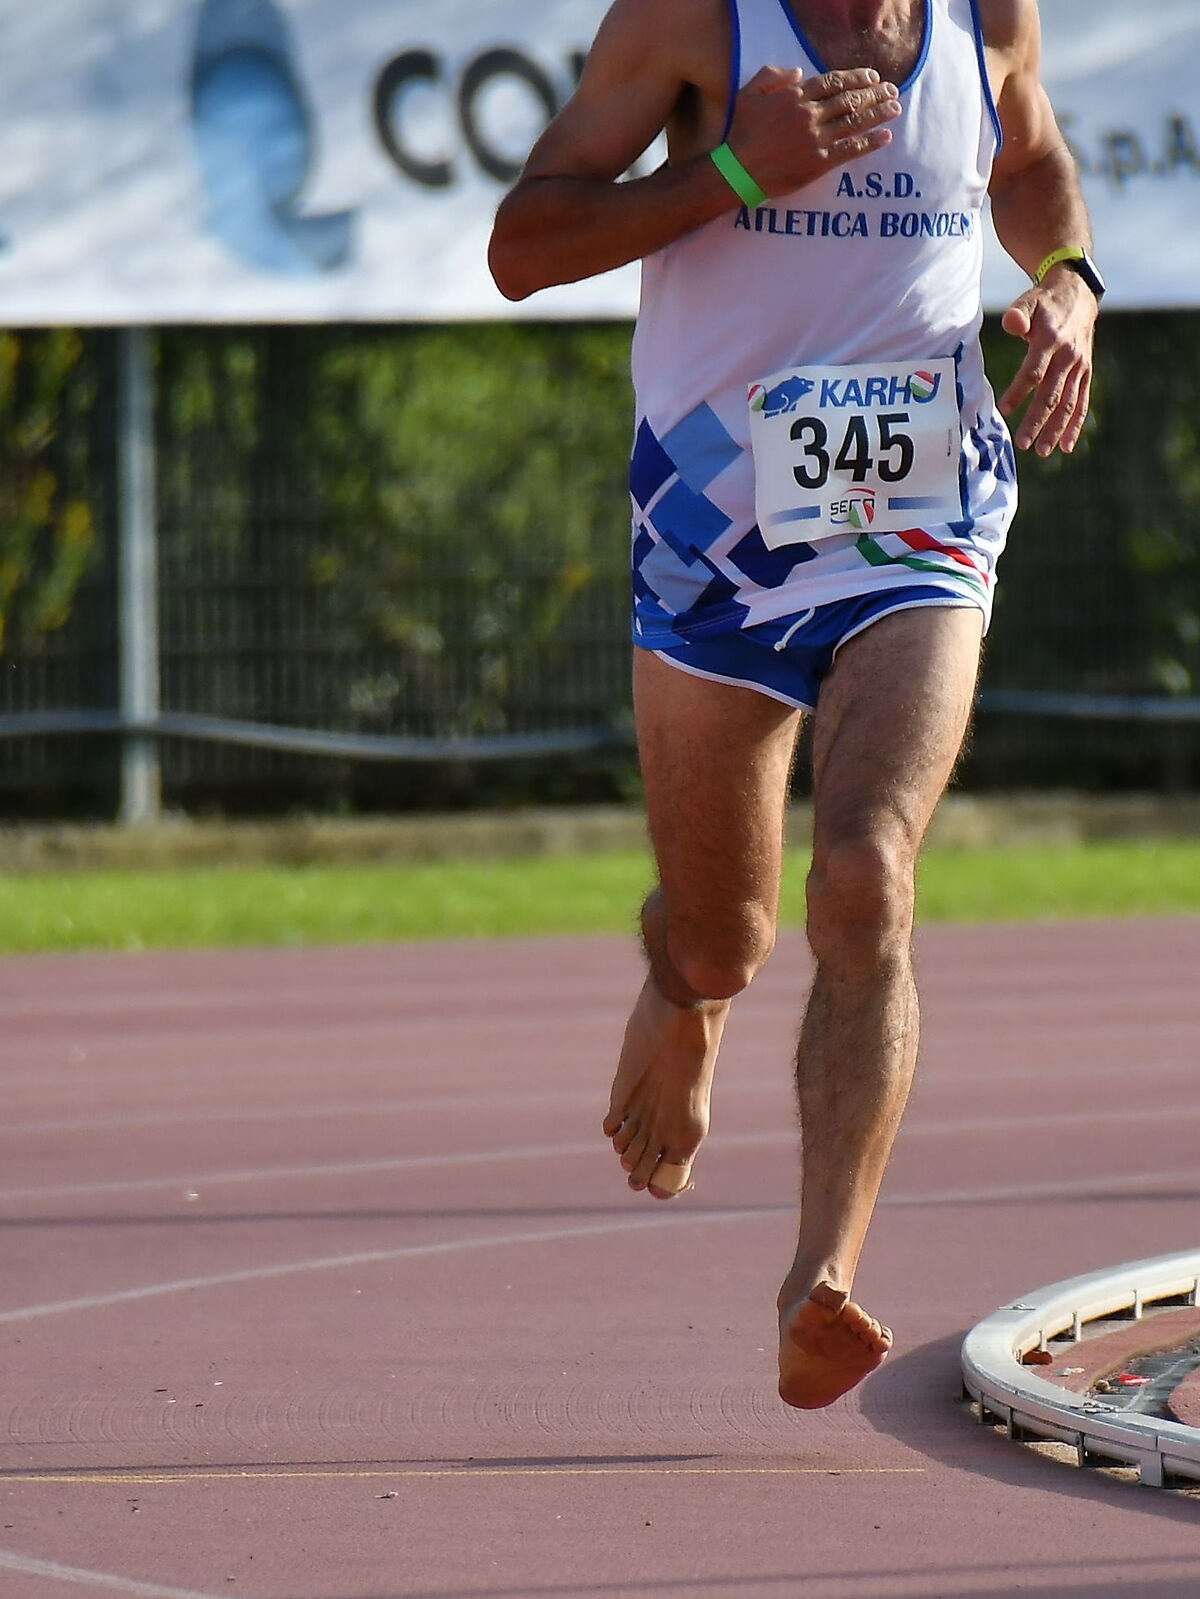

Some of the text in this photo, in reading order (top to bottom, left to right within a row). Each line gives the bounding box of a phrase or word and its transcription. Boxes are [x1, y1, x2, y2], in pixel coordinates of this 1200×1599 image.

[836, 172, 921, 198] A.S.D.
[734, 206, 869, 237] ATLETICA
[790, 412, 914, 489] 345
